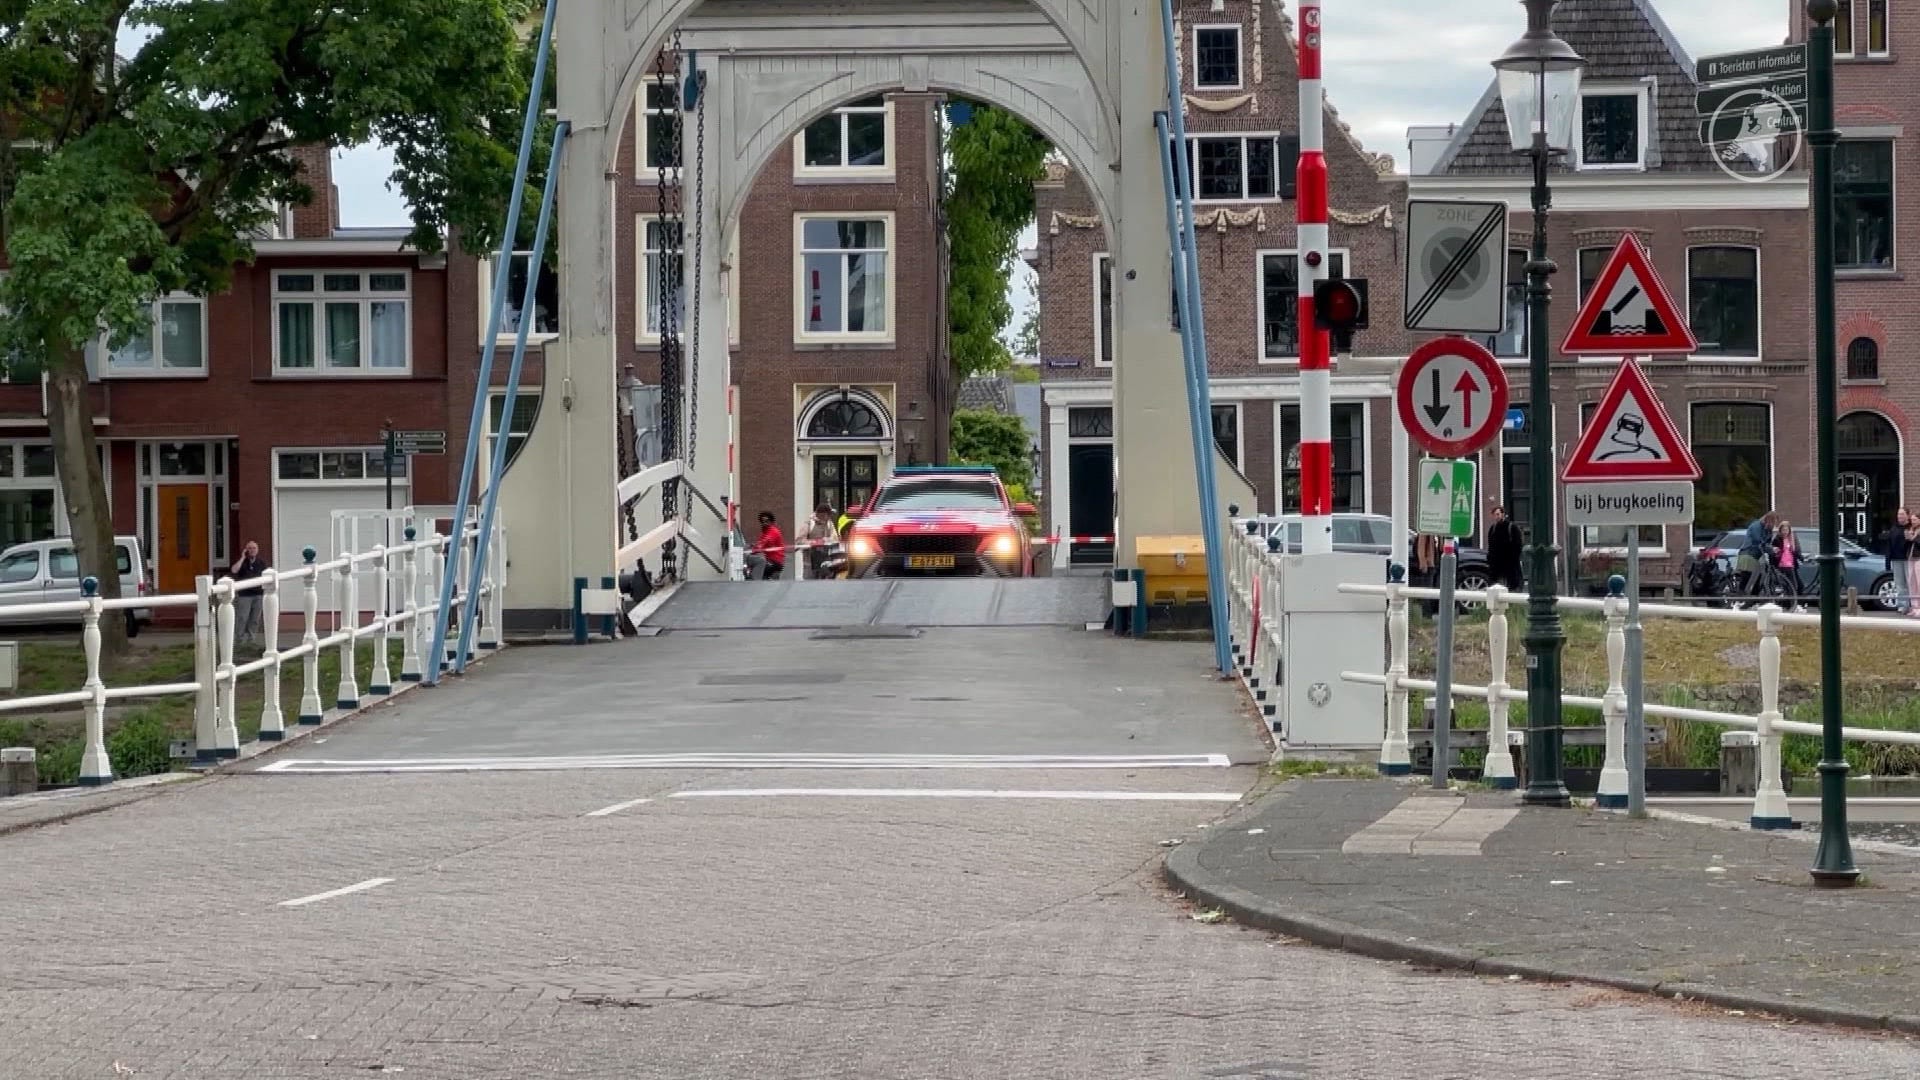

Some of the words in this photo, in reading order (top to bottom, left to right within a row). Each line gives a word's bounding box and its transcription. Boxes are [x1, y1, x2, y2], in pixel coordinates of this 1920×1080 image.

[1719, 58, 1756, 74] Toeristen
[1758, 51, 1801, 70] informatie
[1437, 207, 1475, 222] ZONE
[1574, 494, 1593, 514] bij
[1597, 492, 1685, 514] brugkoeling
